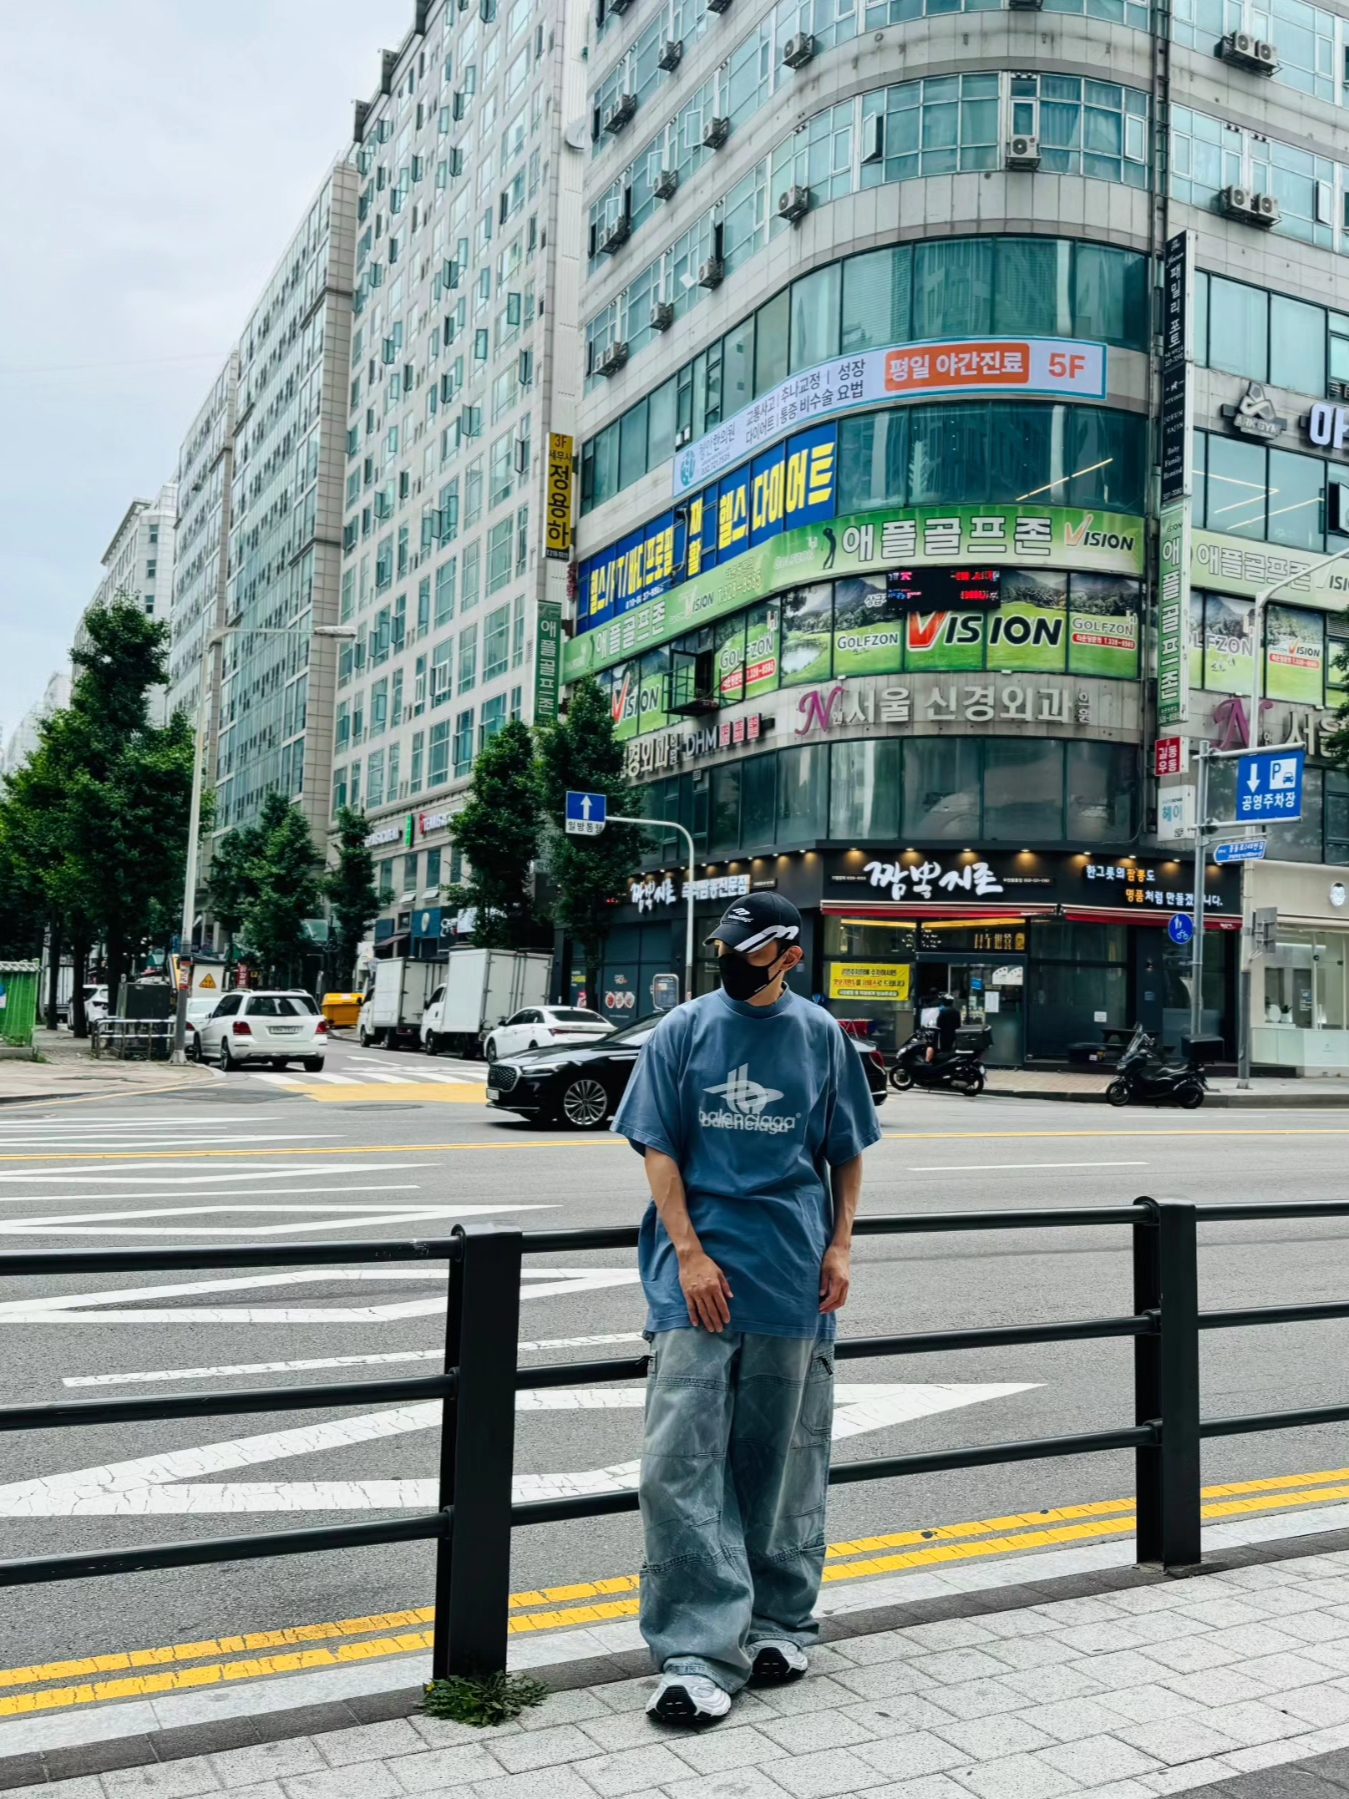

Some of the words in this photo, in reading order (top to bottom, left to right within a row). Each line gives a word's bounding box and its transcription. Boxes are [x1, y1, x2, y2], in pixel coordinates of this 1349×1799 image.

[781, 371, 822, 403] 추나교정
[838, 358, 867, 382] 성장
[889, 354, 930, 382] 평일
[936, 350, 1023, 377] 야간진료
[1048, 352, 1086, 379] 5F
[745, 418, 775, 444] 다이어트
[799, 388, 834, 413] 비수술
[837, 379, 864, 401] 요법
[554, 434, 568, 449] 3F
[547, 464, 571, 547] 정용하
[718, 484, 747, 550] 헬스
[752, 442, 835, 532] 다이어트
[841, 515, 1053, 562] 애플골프존
[1064, 514, 1135, 551] VISION
[1196, 543, 1311, 592] 애플골프존
[596, 600, 666, 661] 애플골프존
[905, 609, 1064, 651] VISION
[1072, 616, 1134, 636] GOLFZON
[1161, 535, 1181, 701] 애플골프존
[836, 631, 899, 651] GOLFZON
[1288, 637, 1321, 658] VISION
[846, 687, 911, 723] 서울
[924, 686, 1072, 723] 신경외과
[1078, 693, 1090, 724] 의원
[622, 734, 670, 778] 경외과
[685, 726, 718, 757] DHM
[1241, 792, 1296, 812] 공영주차장
[568, 821, 603, 834] 일방통행
[863, 860, 1004, 901] 짬뽕지존
[1086, 864, 1126, 881] 한그릇의
[1126, 867, 1156, 883] 짬뽕도
[1125, 888, 1164, 905] 명품처럼
[1165, 893, 1224, 907] 만들겠니다.
